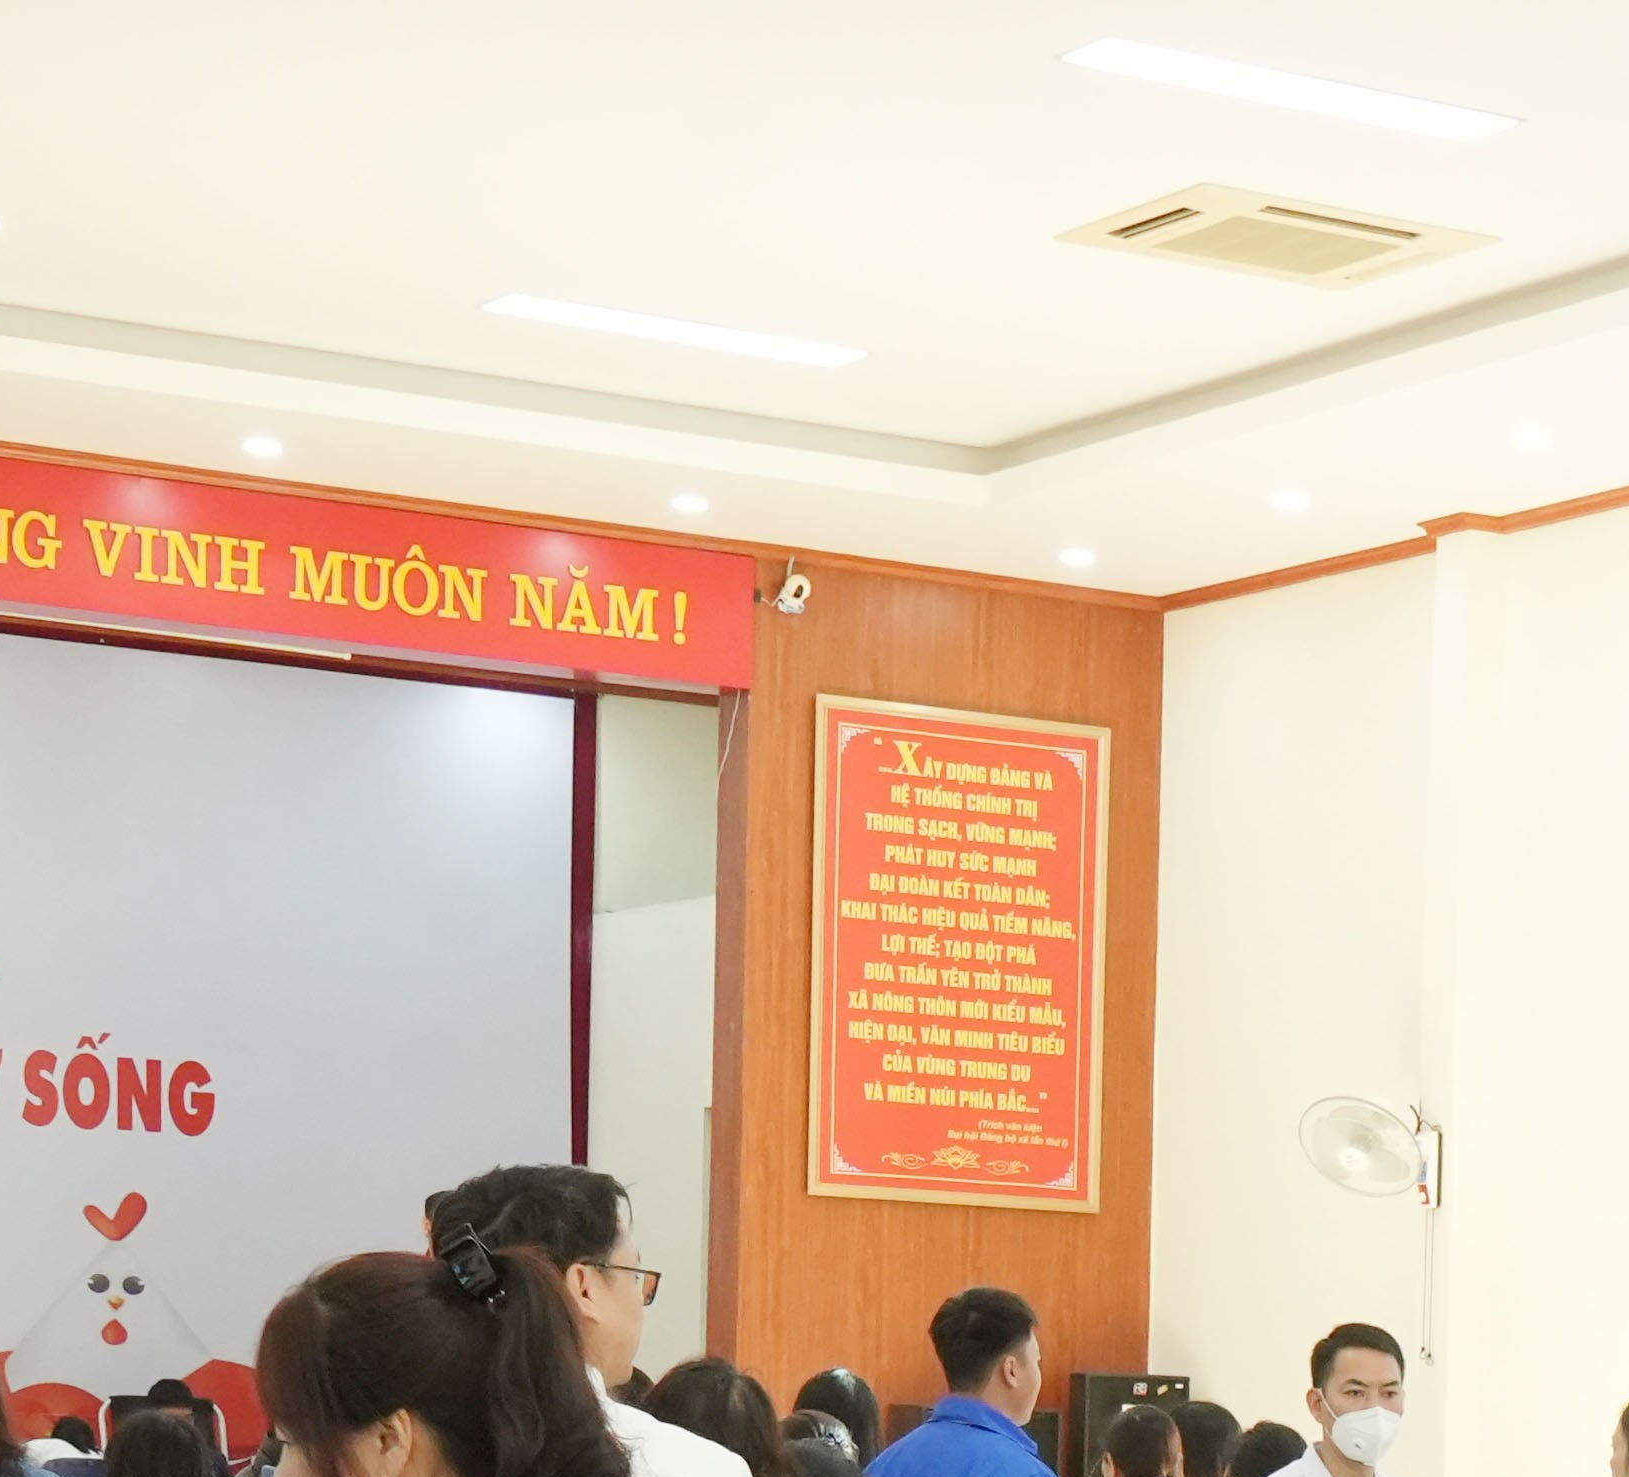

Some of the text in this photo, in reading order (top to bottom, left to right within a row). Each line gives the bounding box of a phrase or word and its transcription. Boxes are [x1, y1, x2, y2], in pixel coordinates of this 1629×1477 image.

[82, 517, 267, 596] VINH
[290, 543, 489, 623] MUÔN
[21, 1031, 218, 1138] SỐNG
